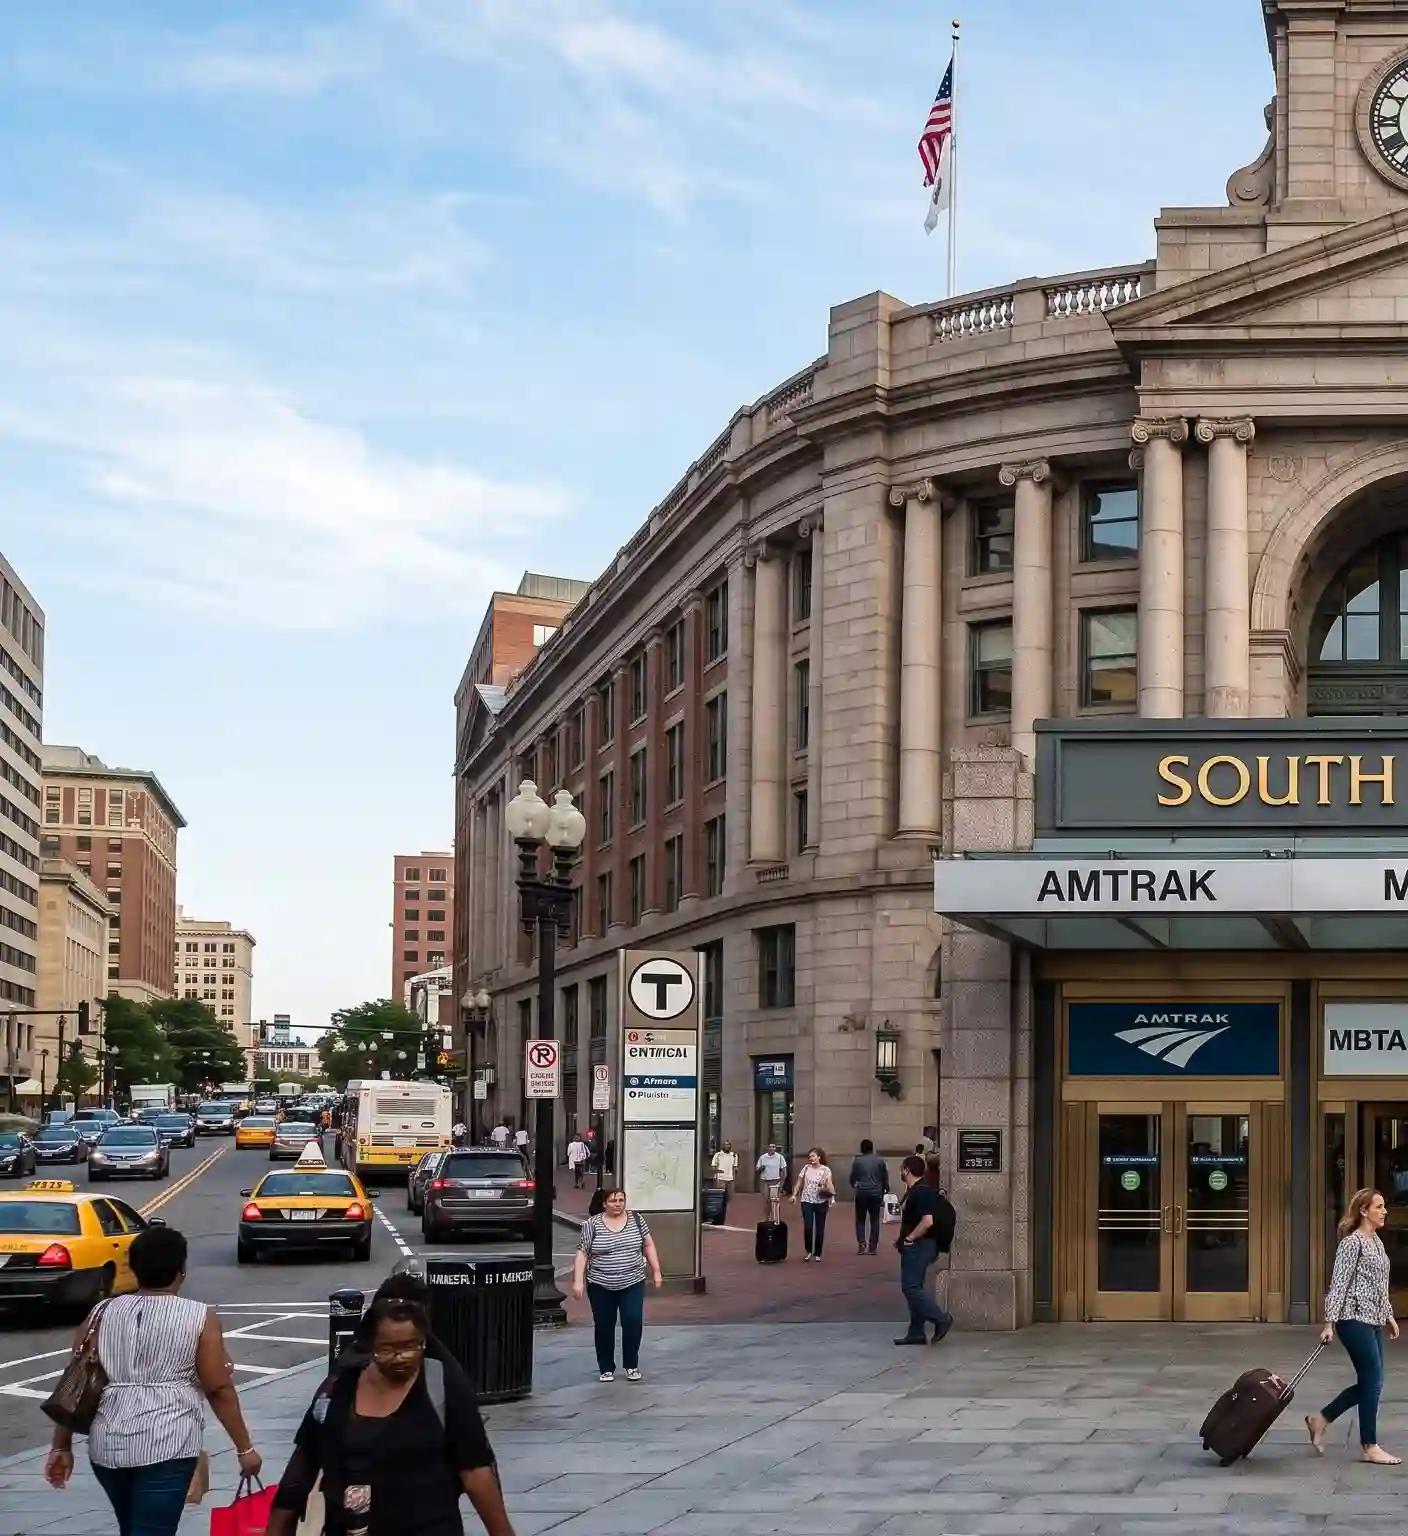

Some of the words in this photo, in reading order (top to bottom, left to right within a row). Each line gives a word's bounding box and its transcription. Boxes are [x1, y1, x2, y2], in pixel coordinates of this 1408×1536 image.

[1157, 755, 1394, 806] SOUTH
[1037, 870, 1217, 902] AMTRAK
[641, 974, 682, 1010] T
[1134, 1014, 1230, 1024] AMTRAK
[1329, 1029, 1407, 1051] MBTA
